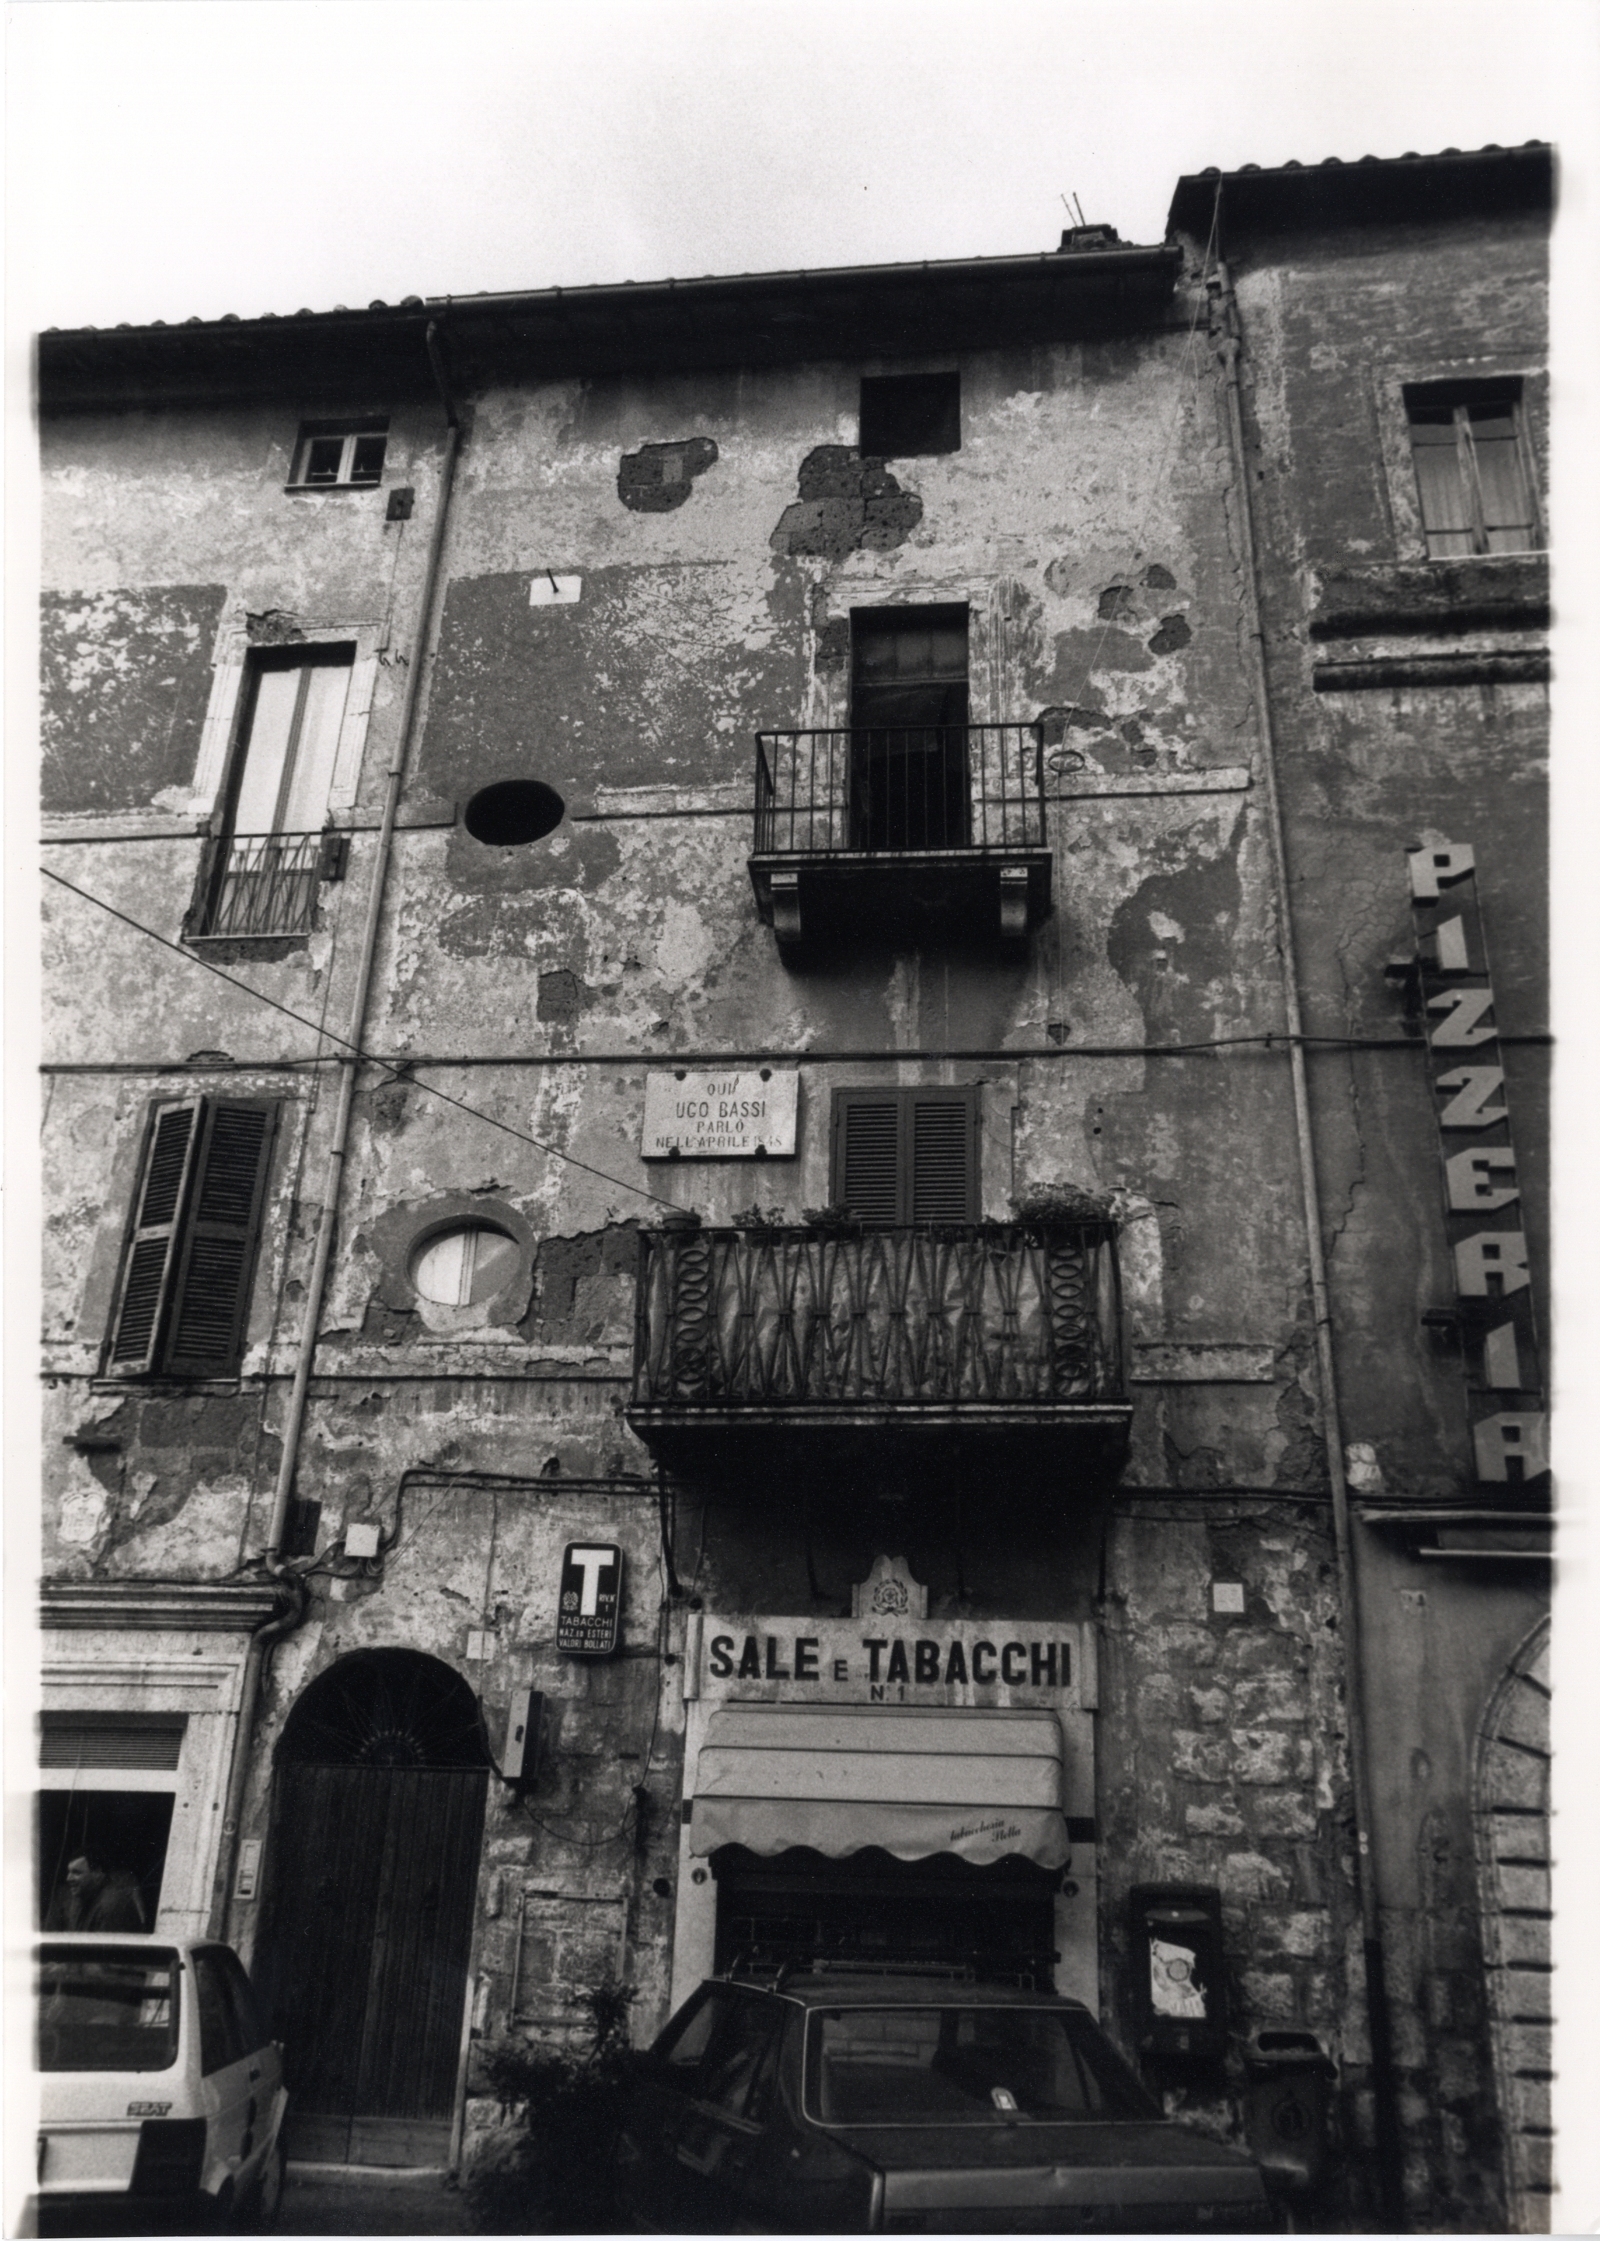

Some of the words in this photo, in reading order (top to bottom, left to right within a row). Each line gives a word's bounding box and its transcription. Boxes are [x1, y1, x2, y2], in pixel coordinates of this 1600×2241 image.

[676, 1102, 709, 1118] UGO
[719, 1100, 766, 1118] BASSI
[1408, 843, 1551, 1482] PIZZERIA
[571, 1549, 614, 1615] T
[561, 1616, 613, 1627] TABACCHI
[587, 1629, 612, 1639] ESTERI
[559, 1639, 581, 1648] VALORI
[583, 1640, 611, 1650] BOLLATI
[710, 1635, 819, 1680] SALE
[834, 1660, 848, 1681] E
[862, 1639, 1072, 1687] TABACCHI
[127, 2101, 173, 2116] SEAT
